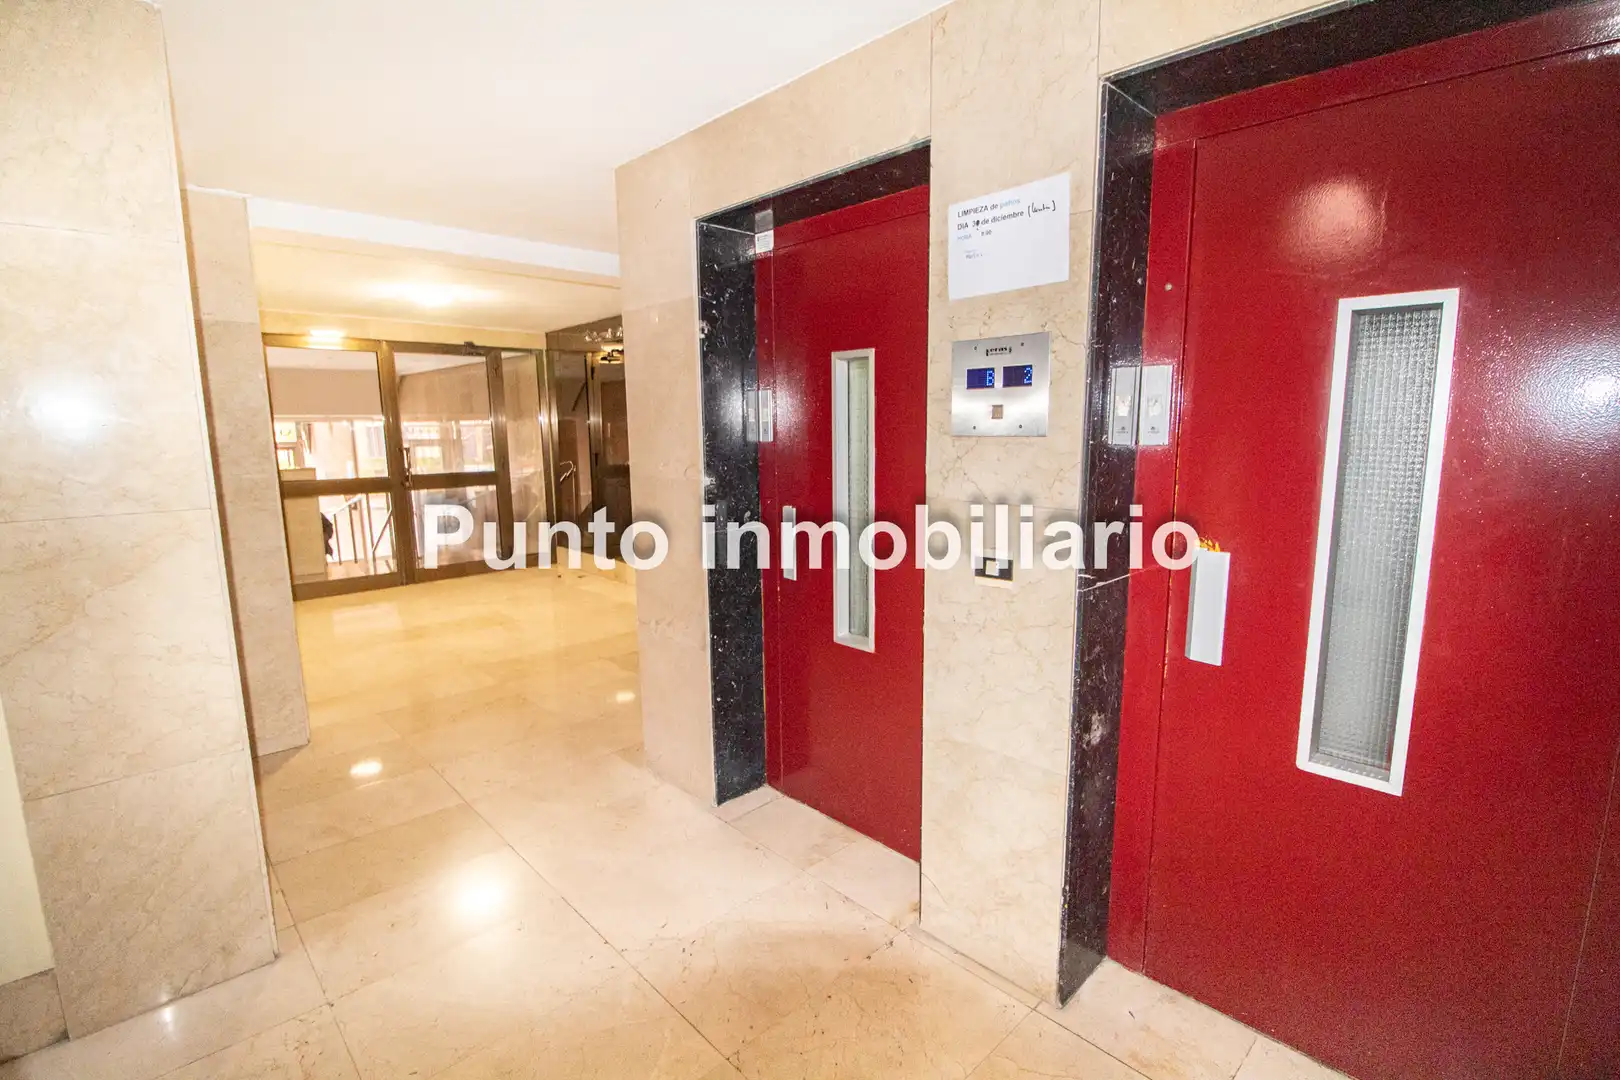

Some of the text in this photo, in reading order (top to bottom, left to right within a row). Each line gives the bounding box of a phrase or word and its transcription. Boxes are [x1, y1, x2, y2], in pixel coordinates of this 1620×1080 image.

[957, 205, 989, 218] LIMPIEZA
[990, 203, 999, 211] de
[981, 218, 990, 226] de
[991, 210, 1025, 224] diciembre
[1024, 367, 1032, 384] 2
